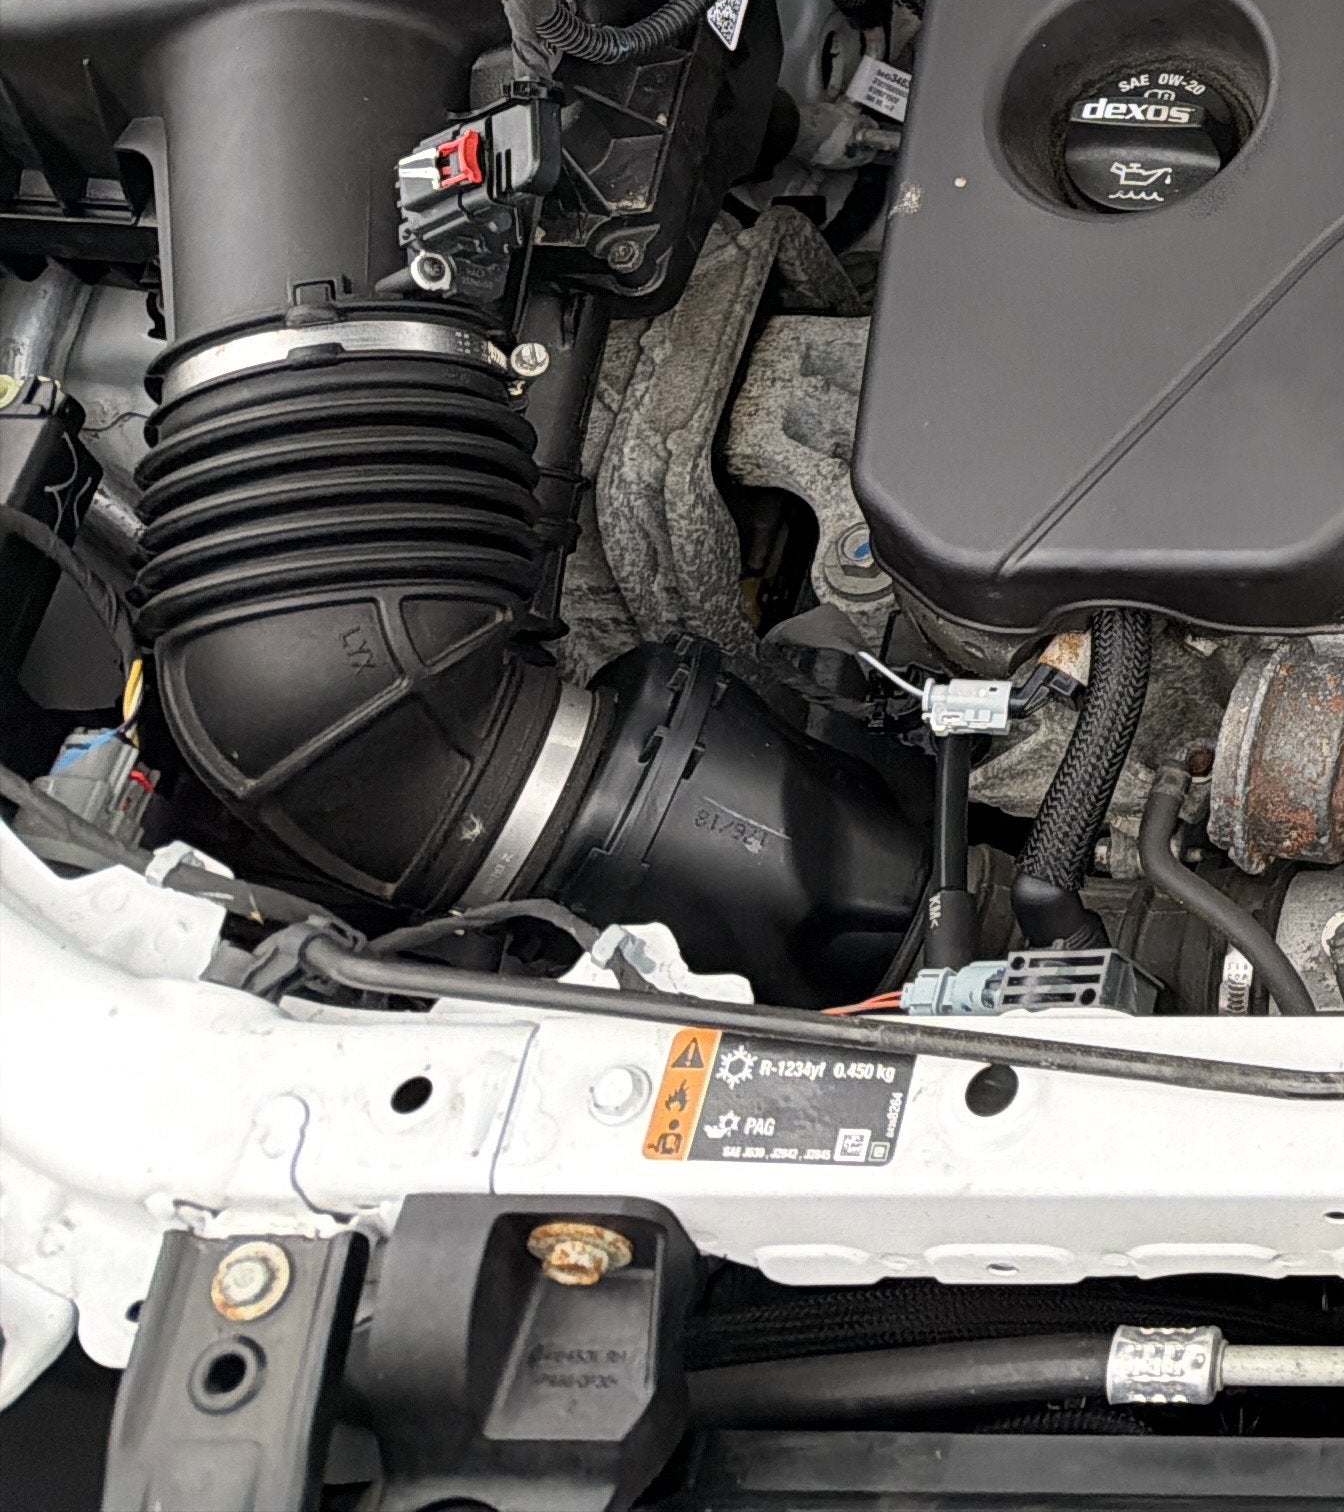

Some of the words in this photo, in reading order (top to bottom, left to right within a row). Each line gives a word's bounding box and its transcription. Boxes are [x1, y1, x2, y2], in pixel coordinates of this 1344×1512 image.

[1118, 74, 1150, 92] SAE
[1158, 73, 1206, 96] 0W-20
[1081, 98, 1195, 124] dexos
[759, 1060, 826, 1081] R-1234yf
[832, 1061, 873, 1081] 0.450
[875, 1065, 896, 1084] kg
[743, 1117, 776, 1136] PAG
